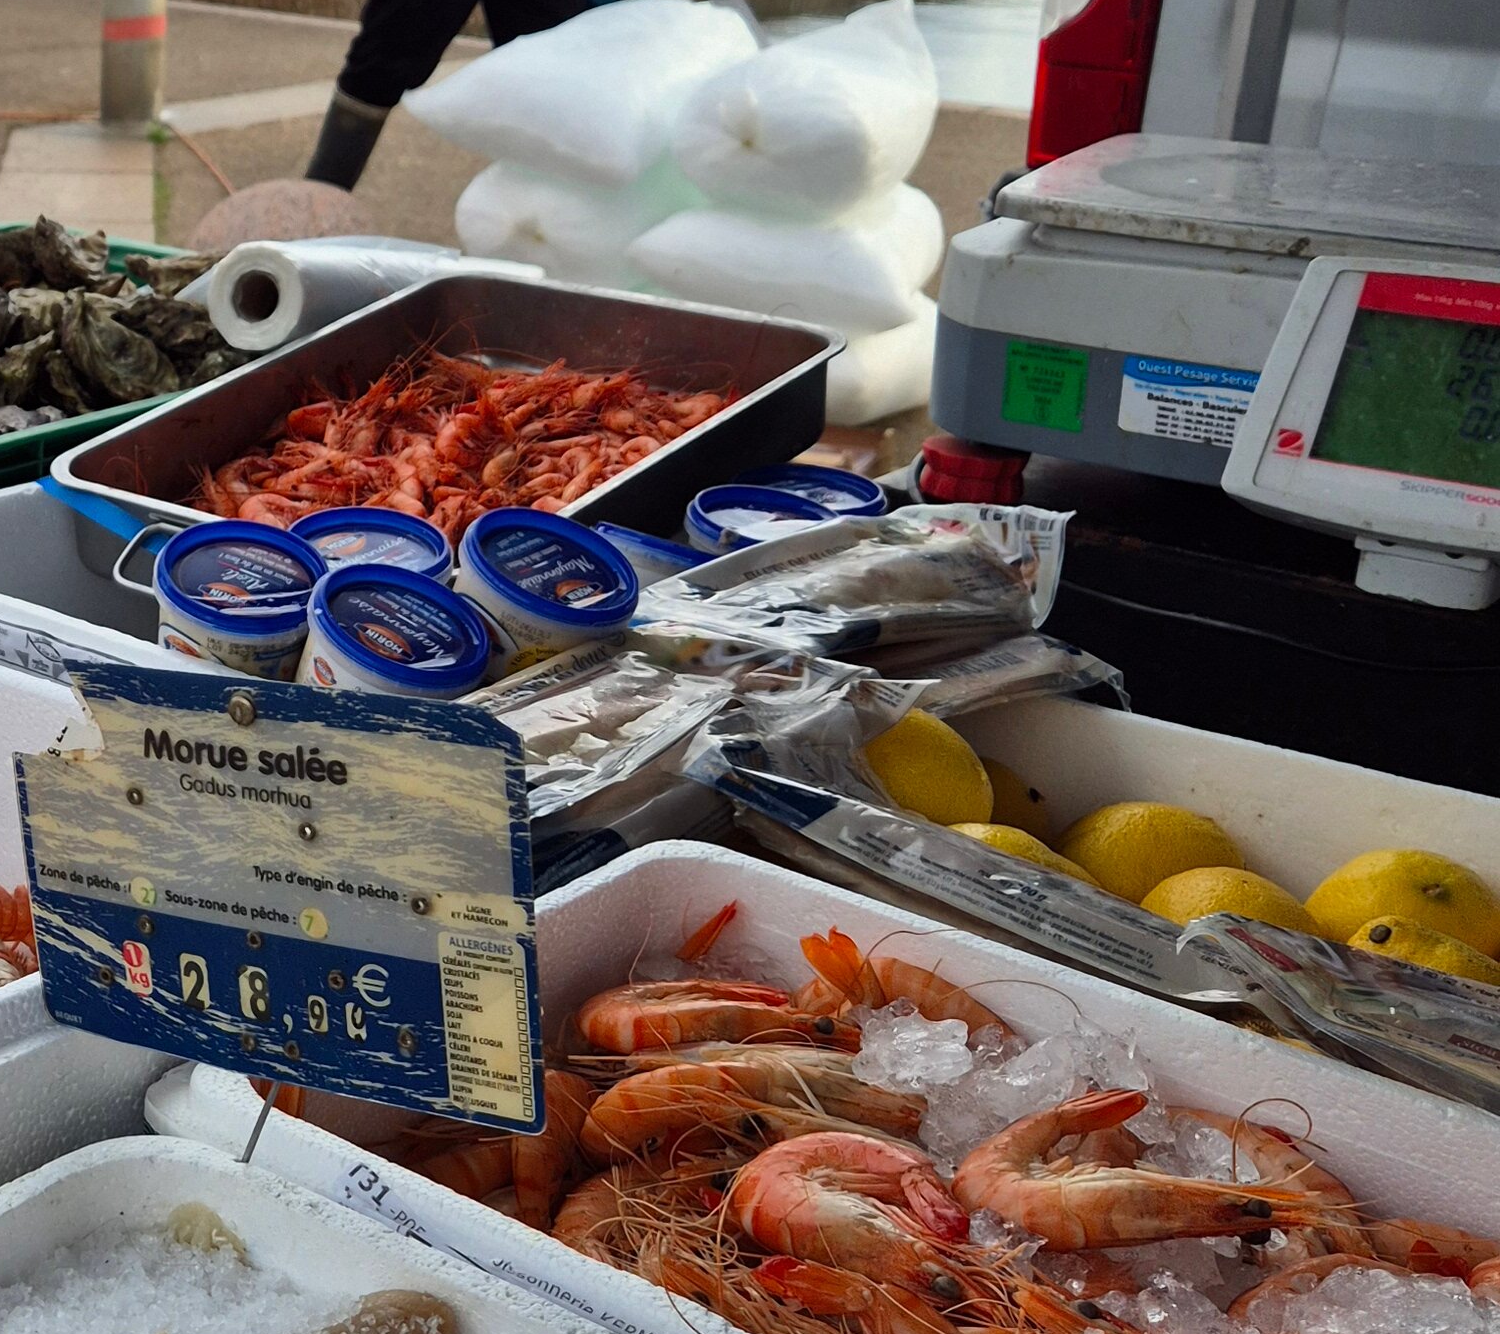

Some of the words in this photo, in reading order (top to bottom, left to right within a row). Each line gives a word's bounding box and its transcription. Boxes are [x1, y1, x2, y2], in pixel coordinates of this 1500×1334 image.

[1139, 360, 1171, 376] Ouest
[1174, 365, 1218, 384] Pesage
[365, 629, 403, 654] MORIN
[143, 727, 248, 771] Morue
[257, 745, 349, 785] salée
[179, 772, 237, 799] Gadus
[241, 785, 312, 810] morhua
[38, 864, 67, 881] Zone
[70, 870, 84, 885] de
[86, 873, 121, 893] pêche
[140, 887, 157, 905] 27
[252, 866, 283, 884] Type
[285, 870, 334, 893] d'engin
[337, 880, 355, 895] de
[357, 883, 400, 903] pêche
[164, 889, 228, 914] Sous-zone
[230, 900, 247, 916] de
[250, 903, 291, 926] pêche
[302, 914, 314, 932] 7
[451, 911, 461, 919] ET
[463, 913, 509, 928] HAMECON
[466, 905, 492, 916] LIGNE
[449, 936, 514, 957] ALLERGÈNES
[129, 969, 150, 988] kg
[444, 989, 479, 1002] POISSONS
[446, 1010, 463, 1020] SOJA
[447, 1020, 461, 1030] LAIT
[450, 1063, 480, 1076] GRAINES
[481, 1069, 490, 1078] DE
